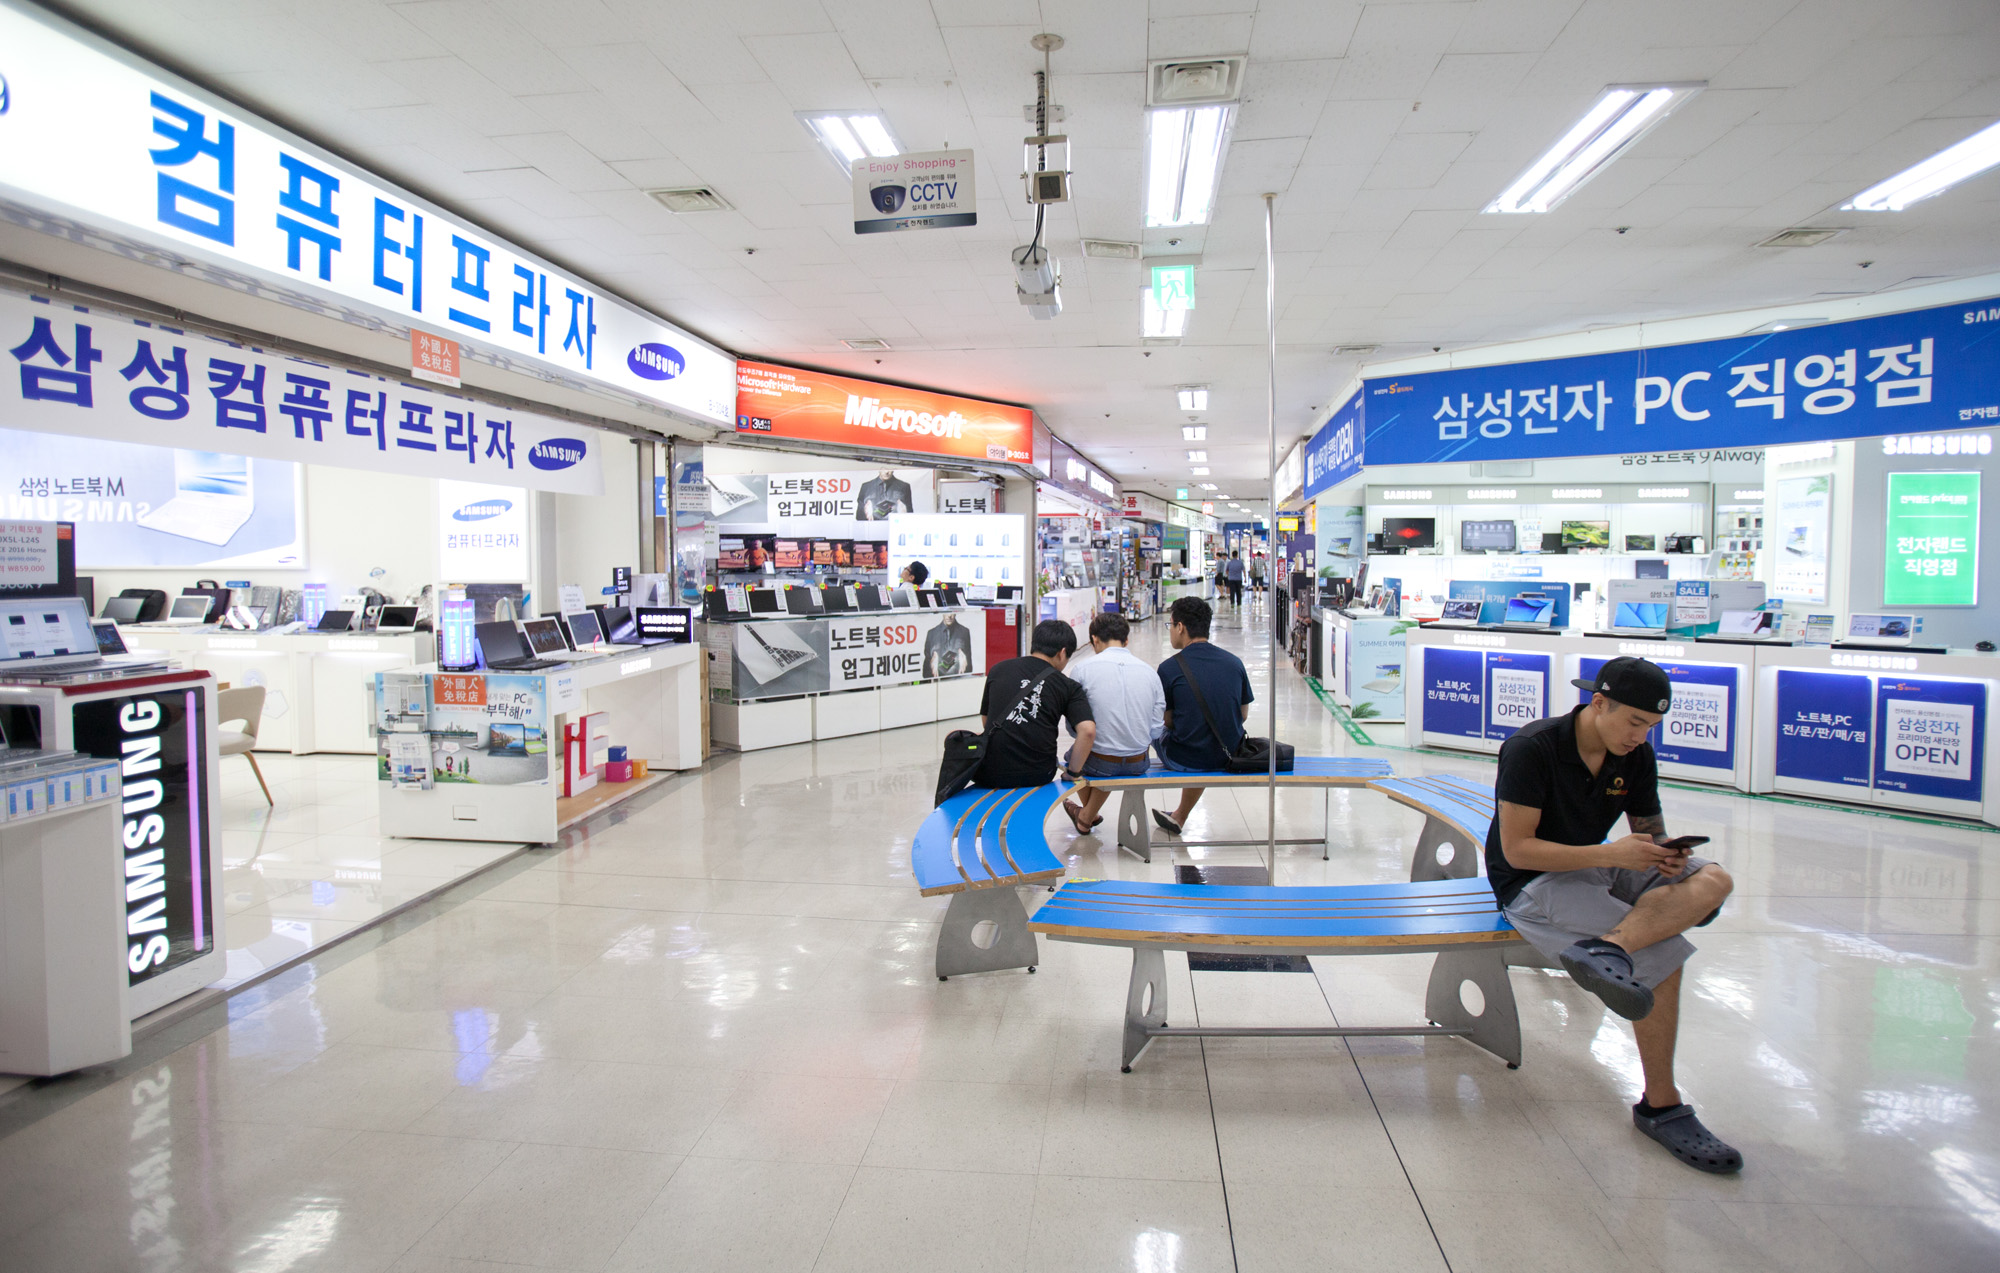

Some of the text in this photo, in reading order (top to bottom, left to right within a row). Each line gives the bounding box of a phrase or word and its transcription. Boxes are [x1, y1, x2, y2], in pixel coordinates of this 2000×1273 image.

[869, 158, 956, 173] Enjoy Shopping
[910, 182, 957, 202] CCTV
[148, 89, 597, 370] 컴퓨터프라자
[634, 345, 681, 376] SAMSUNG
[10, 315, 515, 470] 삼성컴퓨터프라자
[737, 375, 811, 395] Microsoft Hardware
[1433, 336, 1934, 440] 삼성전자 PC 직영점
[844, 394, 964, 440] Microsoft
[1335, 418, 1354, 466] OPEN
[1882, 434, 1992, 455] SAMSUNG
[534, 444, 582, 465] SAMSUNG
[20, 476, 125, 498] 삼성 노트북 M
[769, 478, 851, 496] 노트북 SSD
[1383, 490, 1433, 500] SAMSUNG
[1467, 489, 1517, 500] SAMSUNG
[1552, 488, 1602, 499] SAMSUNG
[1638, 487, 1689, 498] SAMSUNG
[459, 505, 507, 516] SAMSUNG
[777, 500, 855, 518] 업그레이드
[944, 498, 987, 513] 노트북
[447, 534, 519, 549] 컴퓨터프라자
[1896, 537, 1968, 554] 전자랜드
[1905, 559, 1958, 576] 직영점
[1679, 586, 1706, 596] SALE
[640, 614, 687, 625] SAMSUNG
[831, 625, 918, 651] 노트북 SSD
[1453, 634, 1506, 647] SAMSUNG
[1619, 643, 1685, 657] SAMSUNG
[621, 657, 652, 675] SAMSUNG
[841, 652, 922, 680] 업그레이드
[1830, 653, 1918, 670] SAMSUNG
[444, 678, 479, 690] 外國人
[1436, 679, 1471, 691] 노트북,PC
[1498, 682, 1536, 695] 삼성전자
[1427, 690, 1480, 704] 전/문/판/매/점
[1671, 698, 1719, 713] 삼성전자
[1497, 703, 1536, 719] OPEN
[1671, 711, 1719, 723] 프리미엄 새단장
[1796, 711, 1852, 726] 노트북,PC
[1670, 721, 1718, 739] OPEN
[1782, 724, 1866, 743] 전/문/판/매/점
[1897, 717, 1960, 736] 삼성전자
[1897, 733, 1960, 747] 프리미엄 새단장
[1895, 744, 1959, 766] OPEN
[120, 700, 170, 974] SAMSUNG
